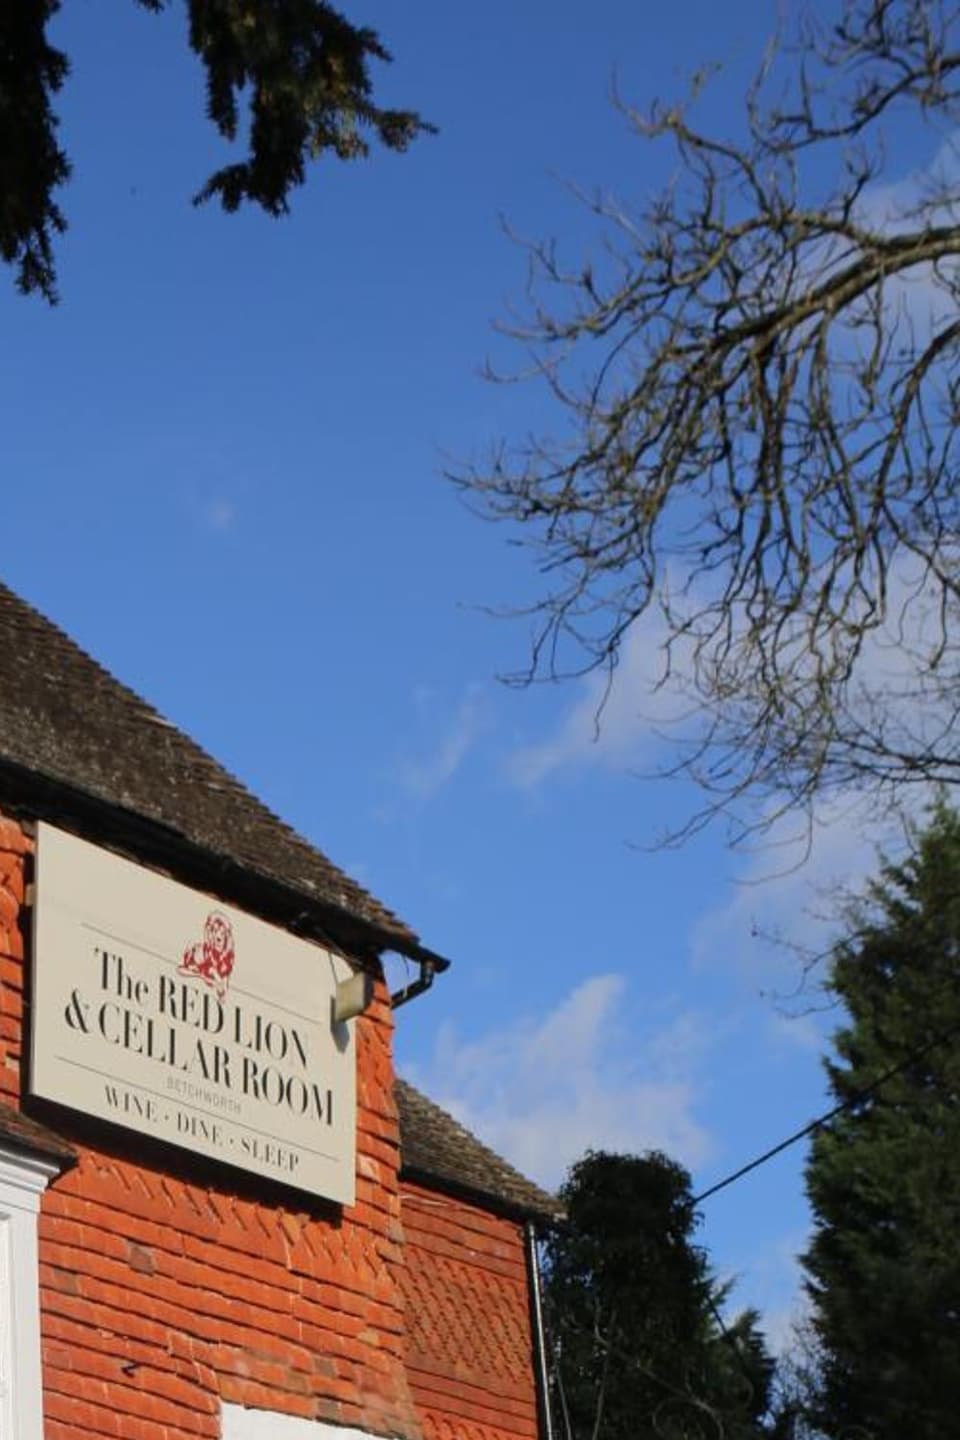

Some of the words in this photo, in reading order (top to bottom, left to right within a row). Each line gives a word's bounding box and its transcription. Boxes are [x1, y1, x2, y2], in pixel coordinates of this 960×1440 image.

[64, 988, 94, 1035] &
[98, 1001, 232, 1088] CELLAR
[242, 1055, 334, 1126] ROOM
[94, 947, 150, 1003] The
[158, 975, 224, 1034] RED
[232, 1005, 308, 1069] LION
[104, 1085, 158, 1123] WINE
[177, 1112, 223, 1147] DINE
[240, 1139, 300, 1173] SLEEP
